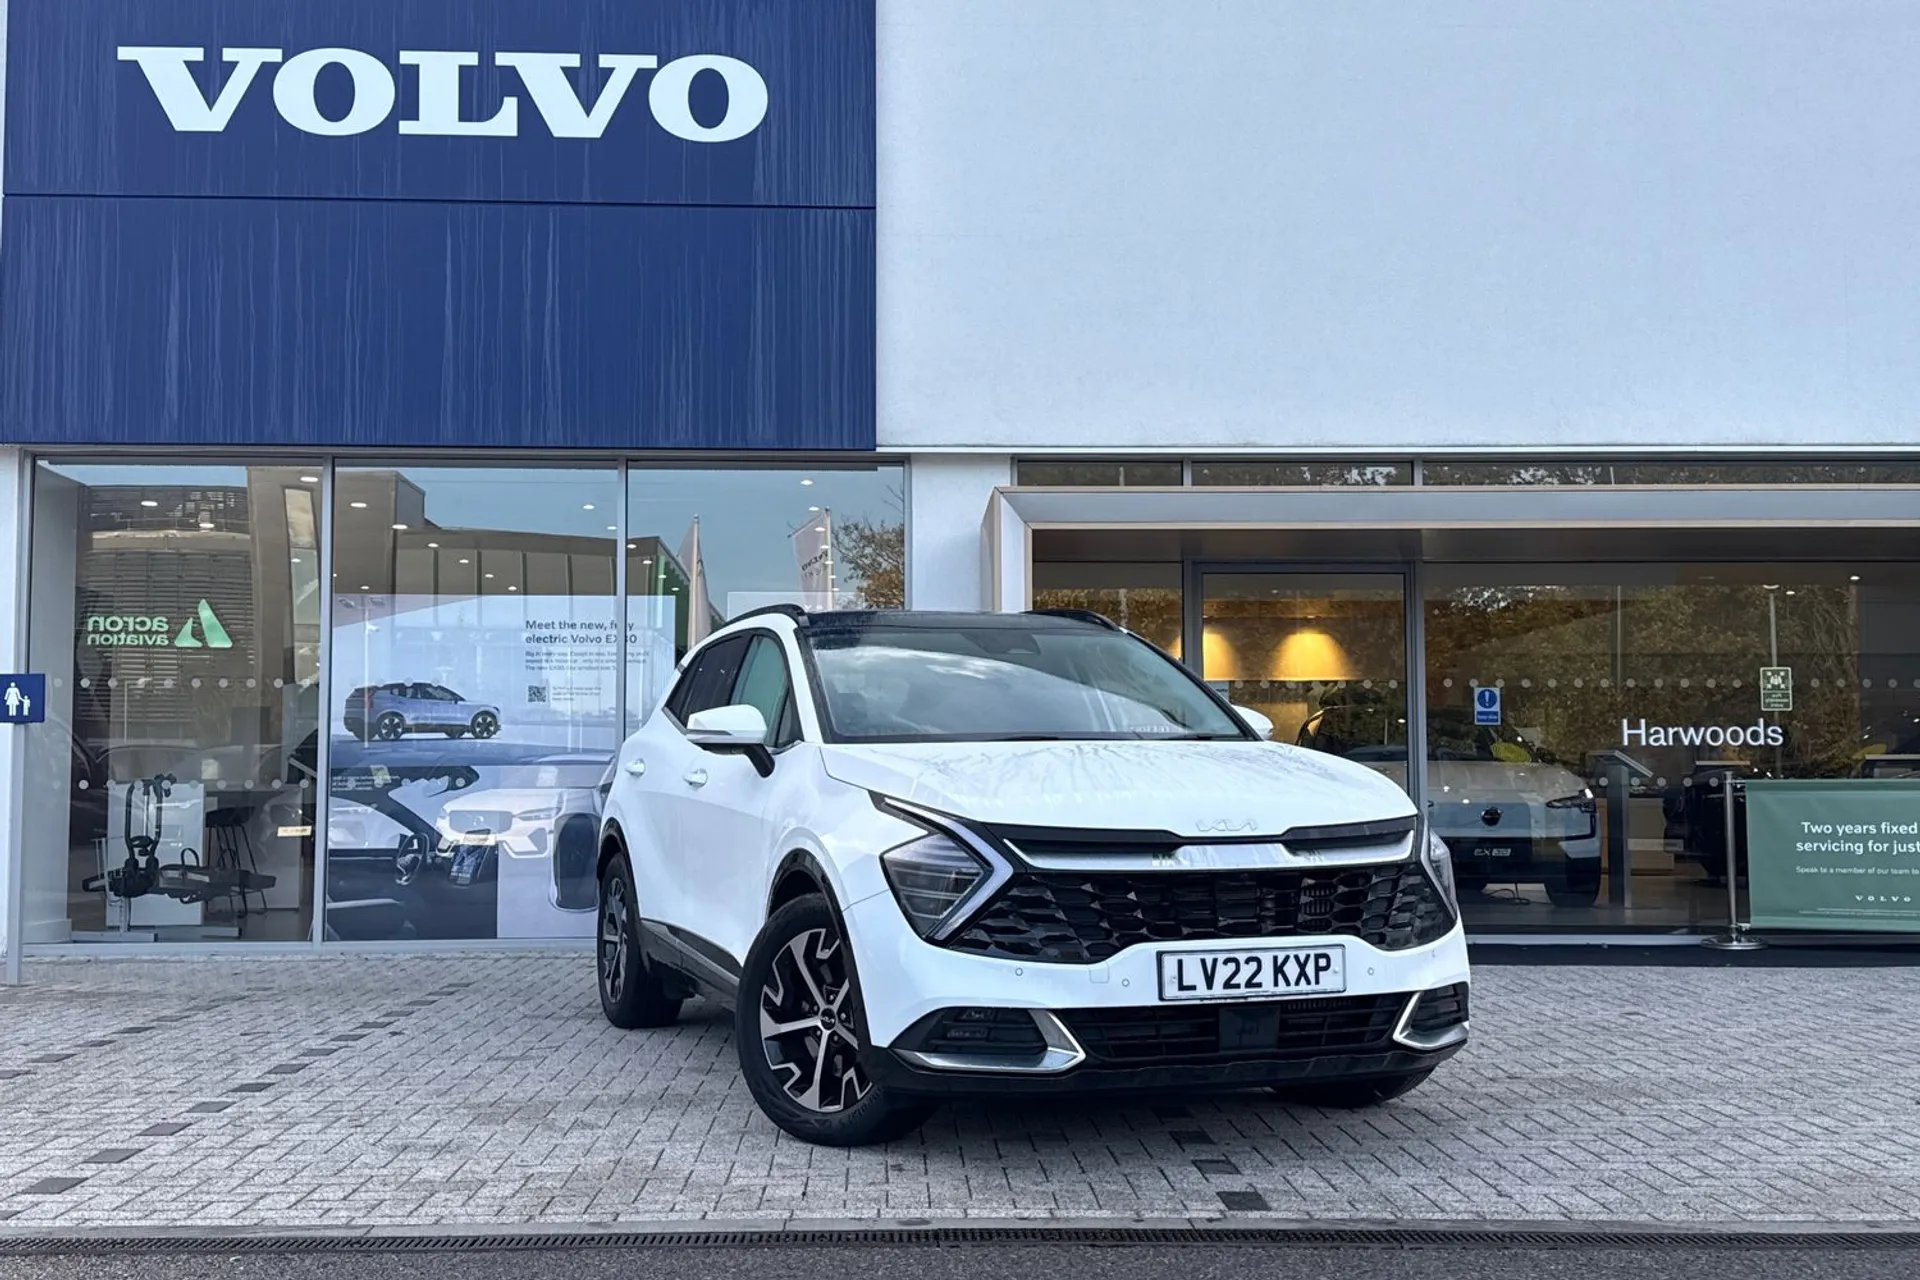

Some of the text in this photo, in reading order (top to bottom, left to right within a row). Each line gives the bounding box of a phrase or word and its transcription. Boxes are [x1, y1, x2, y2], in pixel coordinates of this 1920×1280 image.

[117, 46, 768, 142] VOLVO
[525, 620, 555, 630] Meet
[559, 620, 577, 630] the
[580, 622, 607, 632] new,
[525, 633, 568, 644] electric
[570, 634, 602, 644] Volvo
[1622, 717, 1784, 747] Harwoods
[1801, 821, 1918, 837] Two years fixed
[1795, 839, 1920, 856] servicing for just
[1795, 865, 1819, 874] Speak
[1835, 866, 1866, 874] member
[1867, 866, 1876, 874] of
[1890, 867, 1910, 875] team
[1854, 894, 1912, 902] VOLVO
[1176, 952, 1332, 992] LV22 KXP
